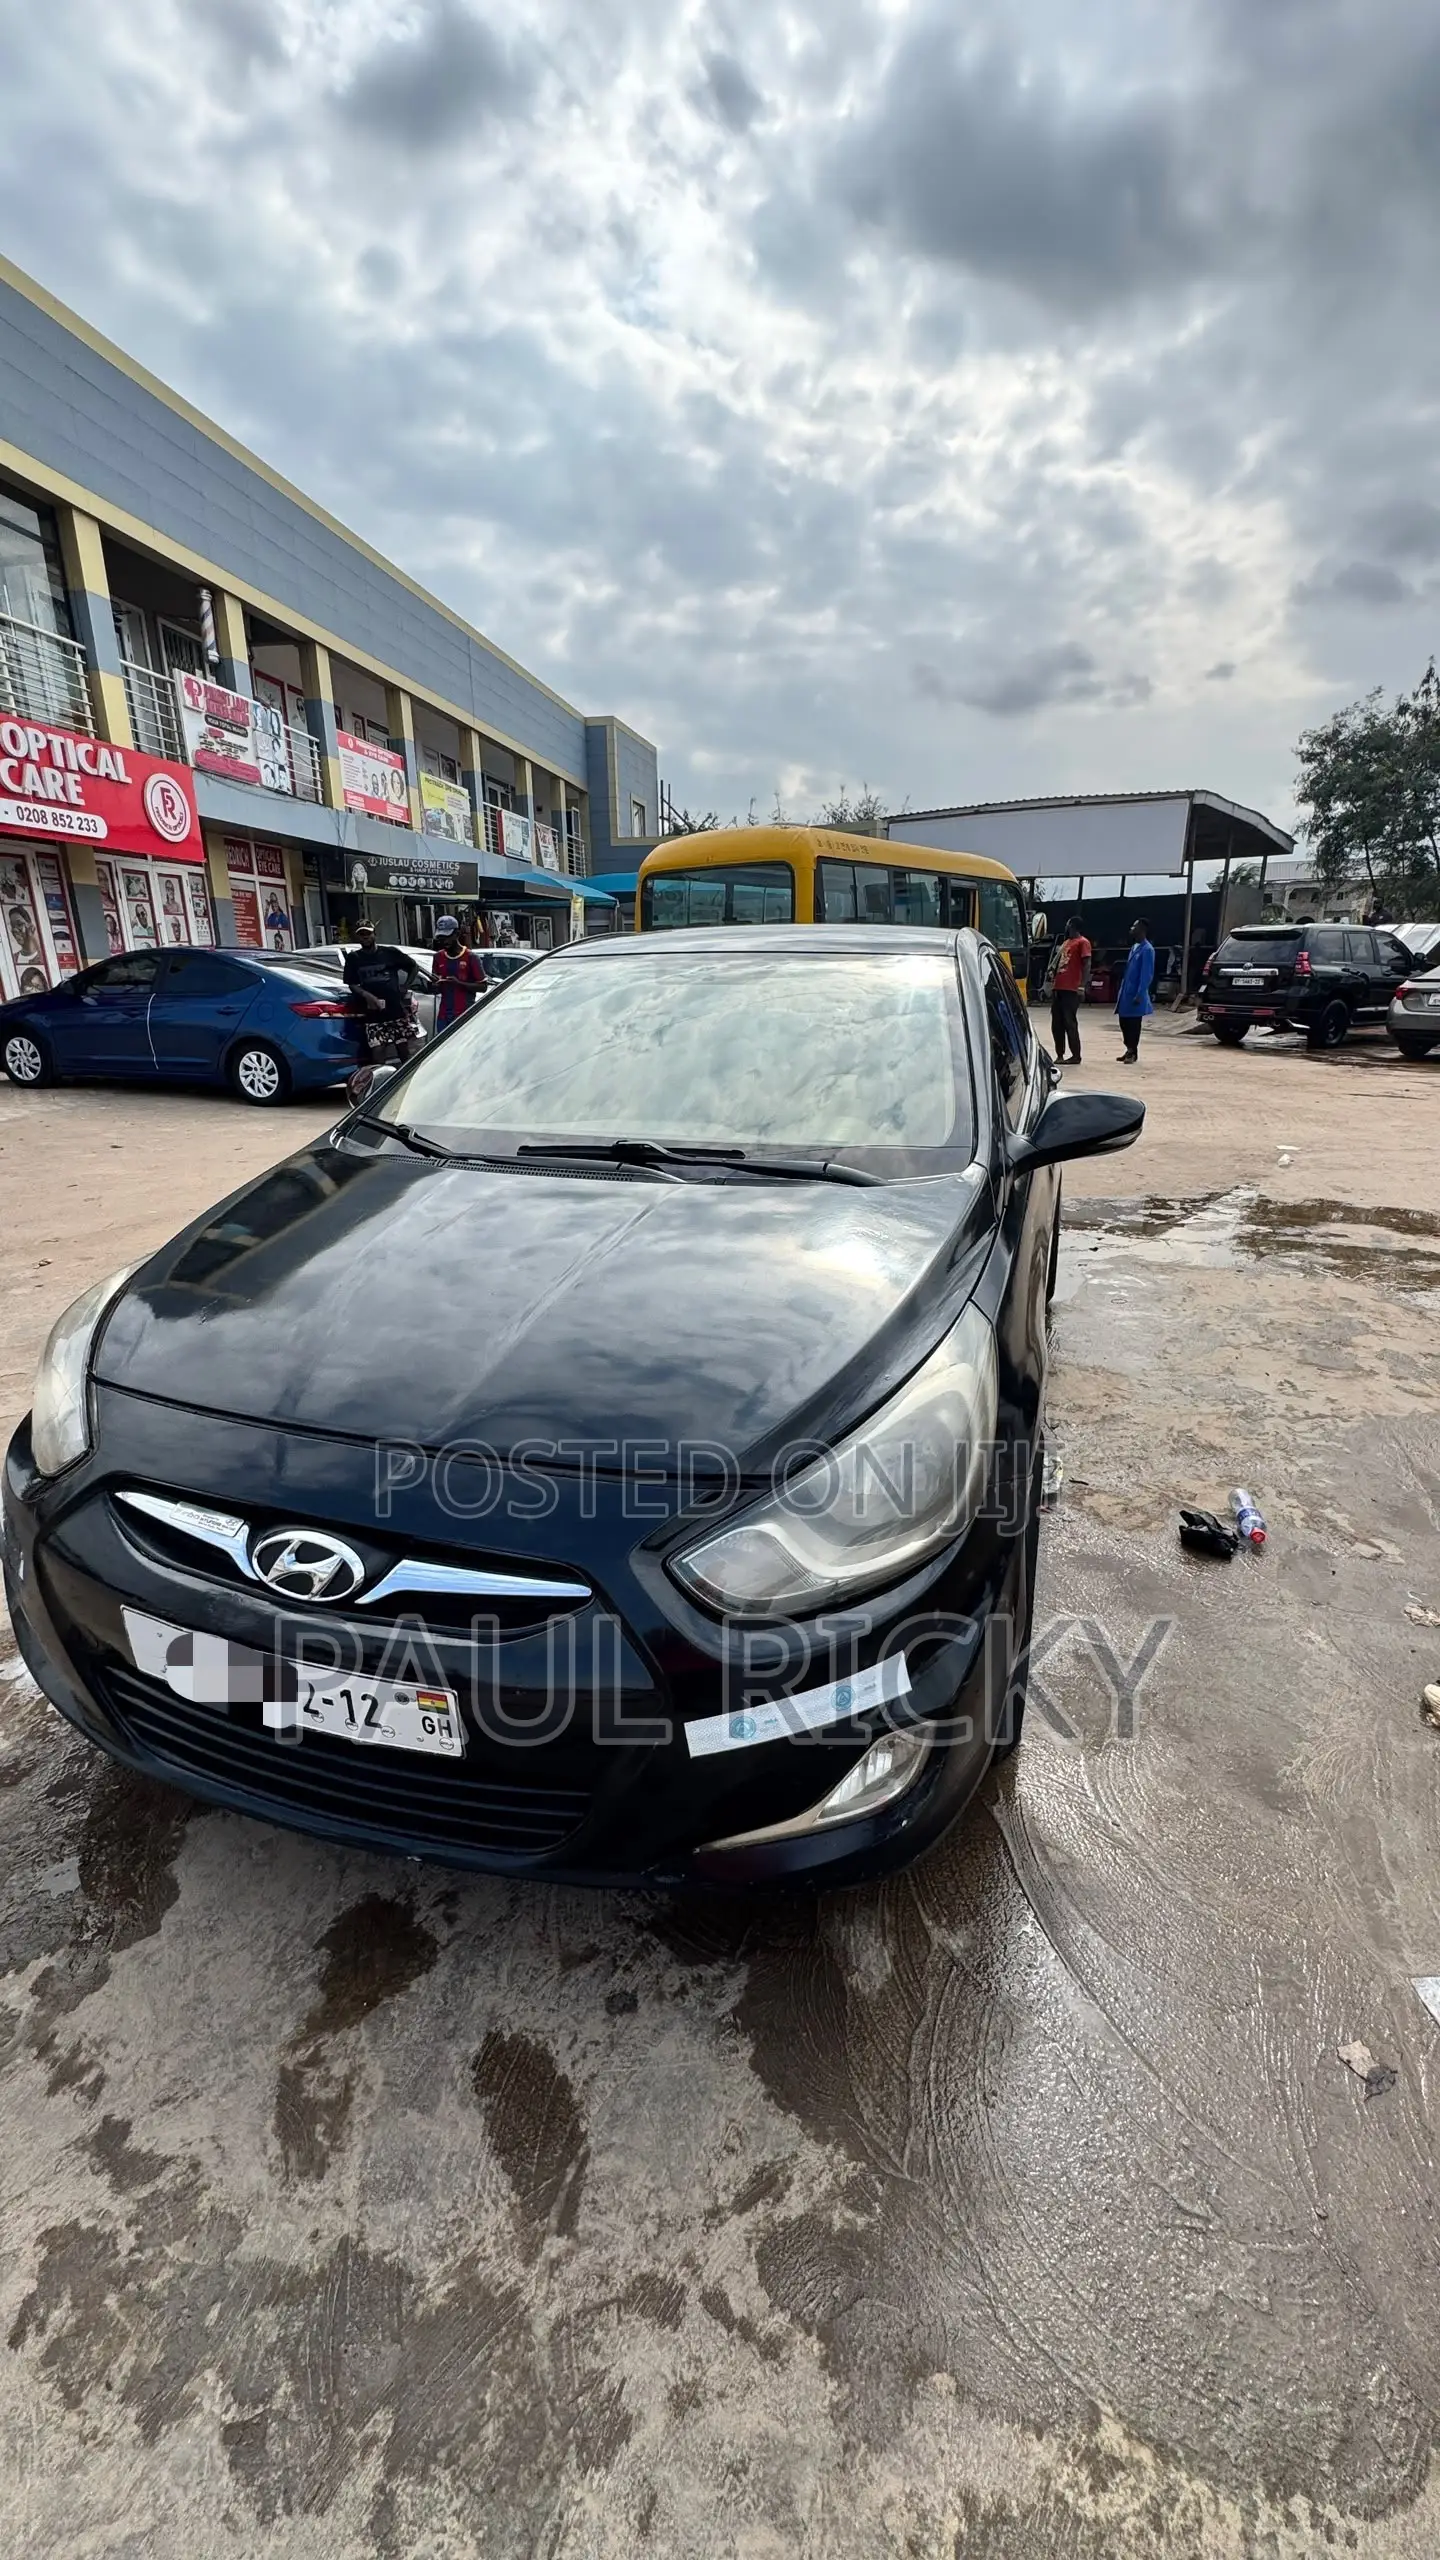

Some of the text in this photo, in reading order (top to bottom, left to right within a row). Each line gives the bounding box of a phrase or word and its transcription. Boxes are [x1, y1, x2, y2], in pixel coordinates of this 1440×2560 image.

[0, 721, 132, 784] OPTICAL
[0, 758, 85, 806] CARE
[16, 805, 48, 825] 0208
[52, 812, 74, 829] 852
[76, 816, 98, 833] 233
[268, 863, 281, 874] CARE
[379, 856, 460, 870] JUSLAU COSMETICS
[421, 1715, 452, 1739] GH
